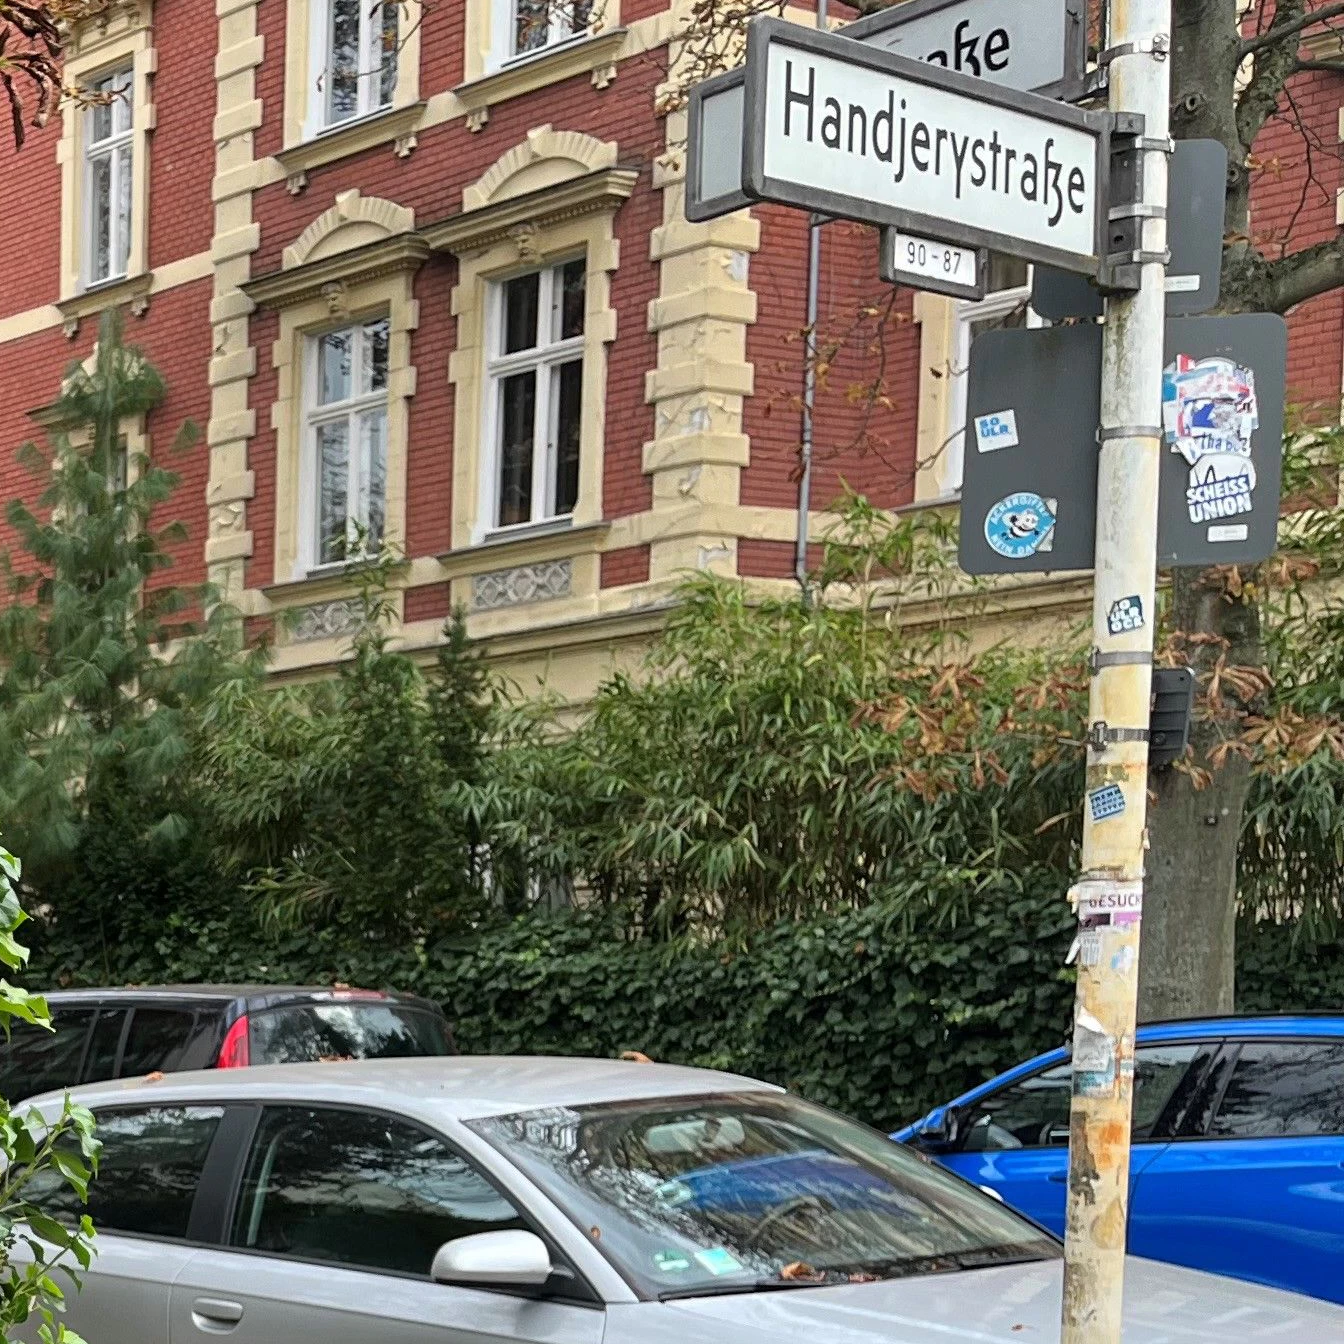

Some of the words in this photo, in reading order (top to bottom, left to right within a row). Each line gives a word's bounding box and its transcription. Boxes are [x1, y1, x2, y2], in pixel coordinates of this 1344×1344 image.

[784, 60, 1086, 227] Handjerystraße
[908, 241, 926, 267] 90
[943, 249, 962, 275] 87
[1186, 475, 1249, 505] SCHEISS
[1189, 492, 1253, 523] UNION
